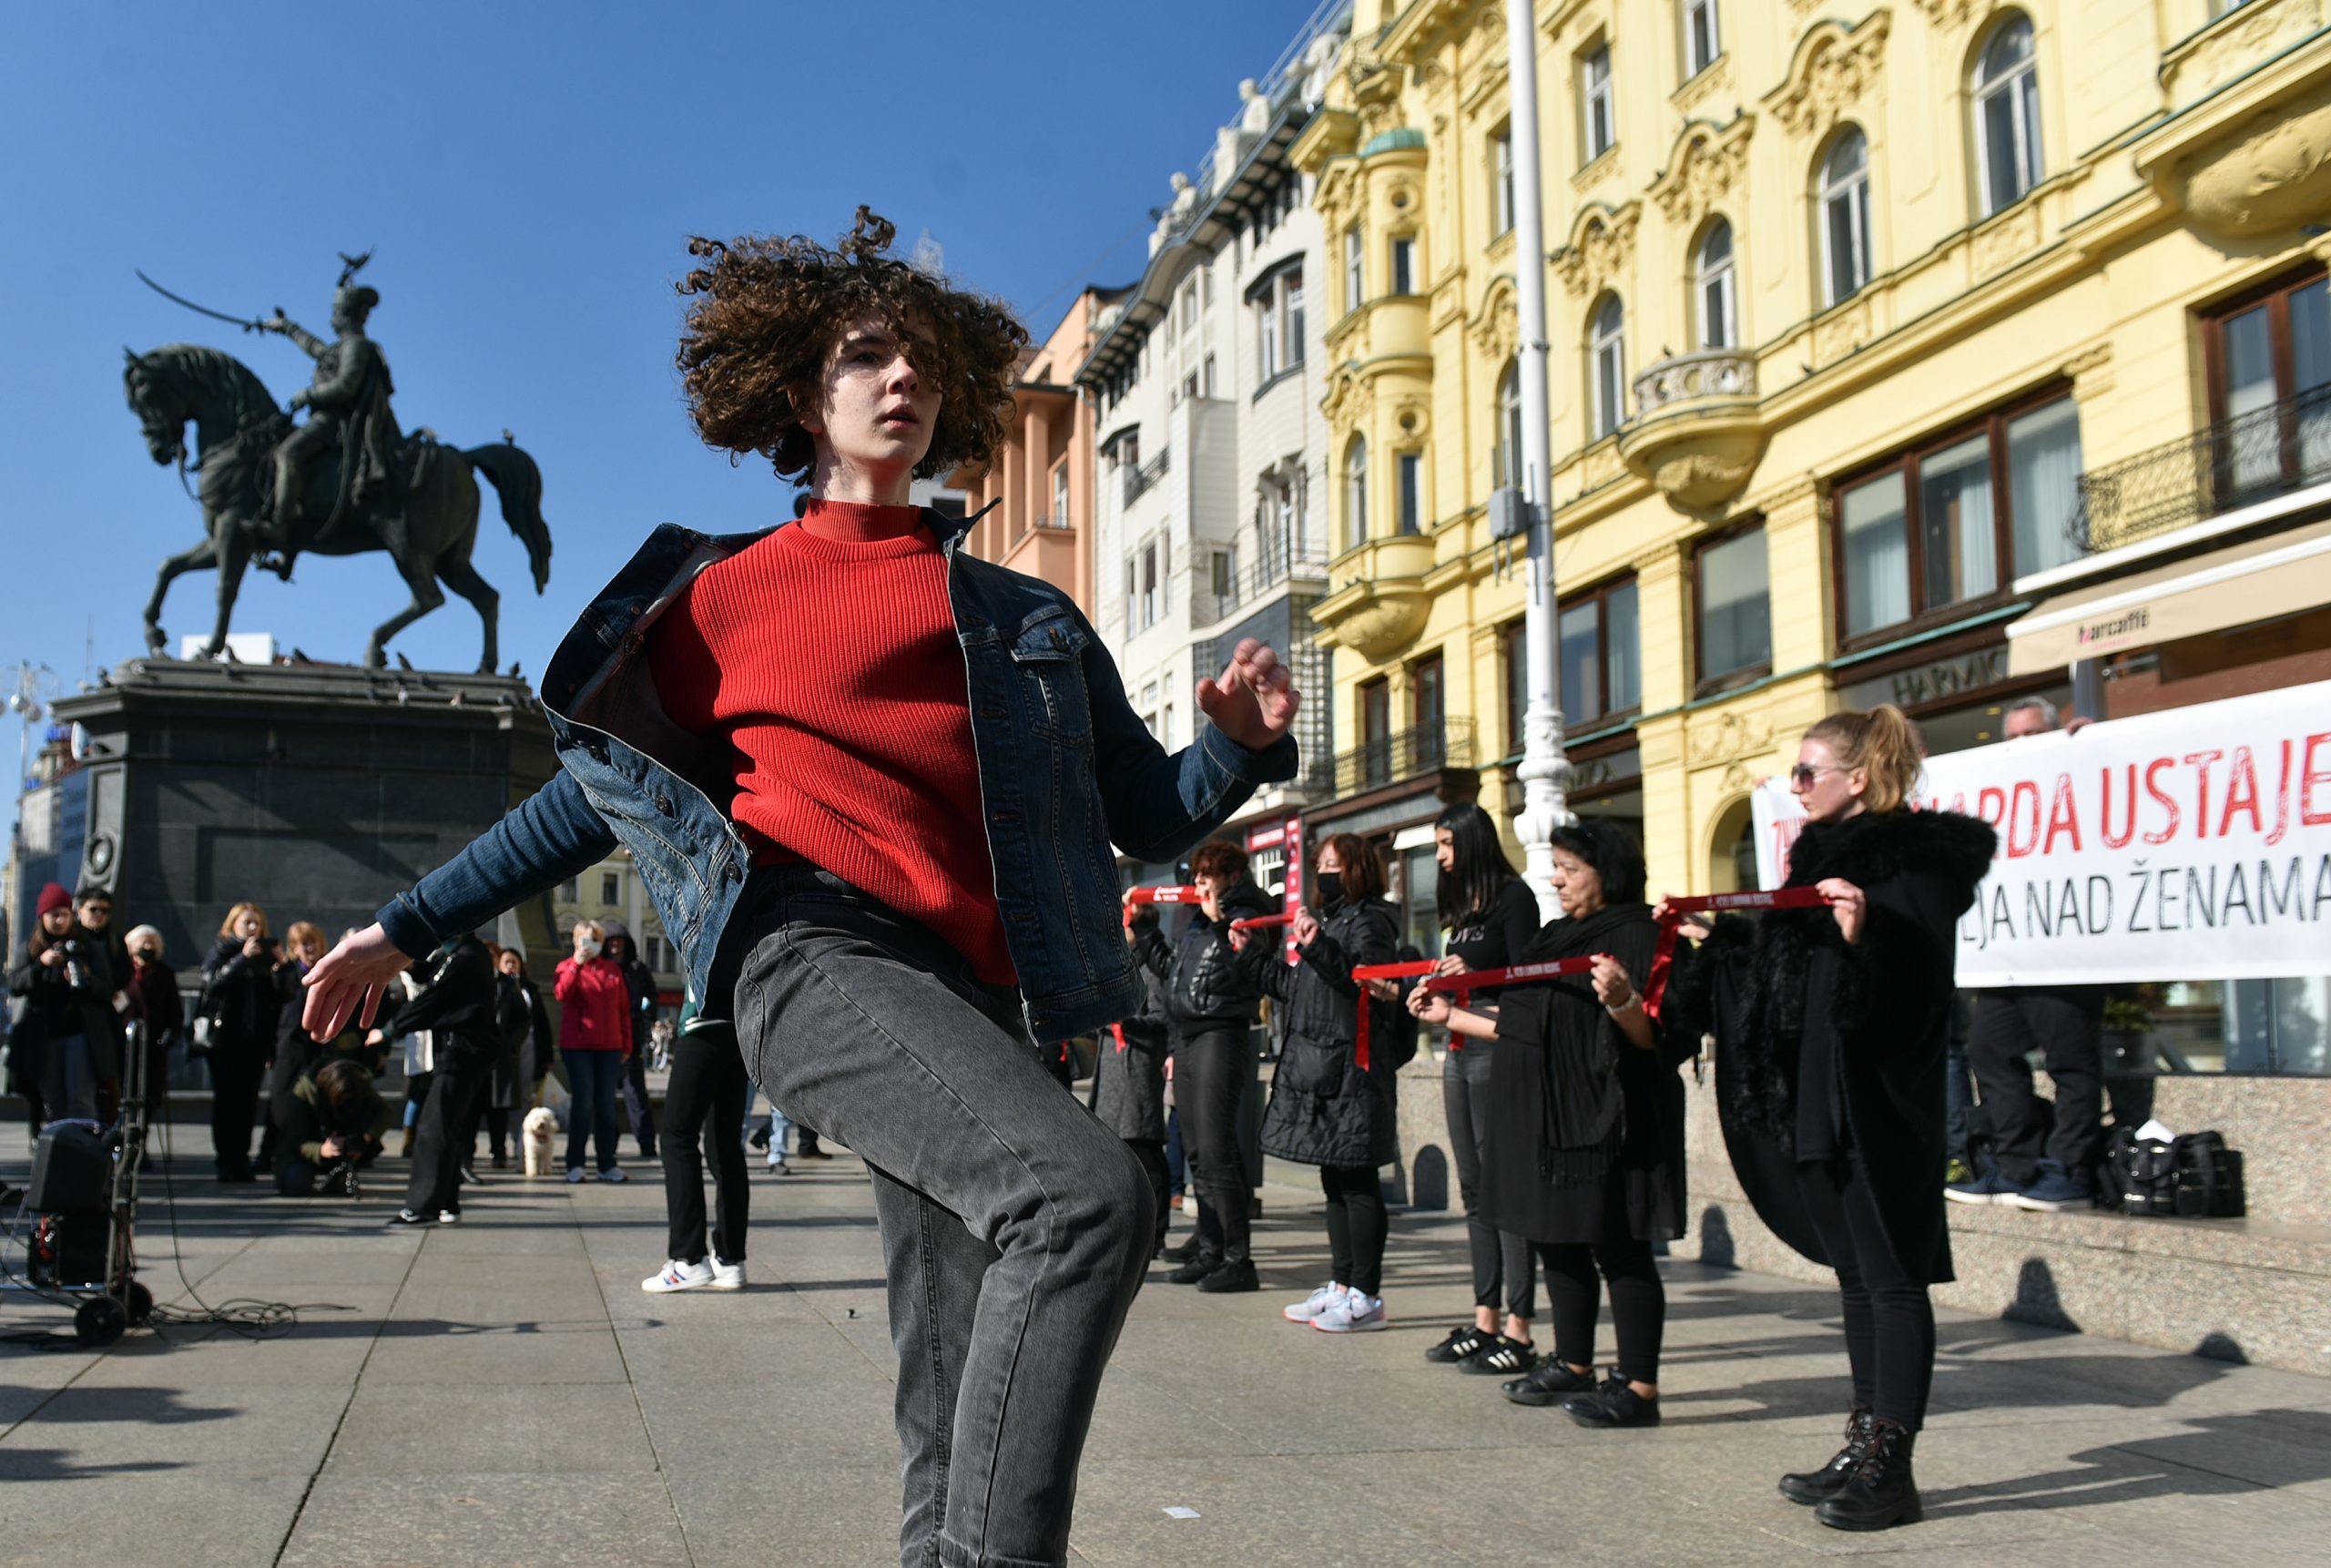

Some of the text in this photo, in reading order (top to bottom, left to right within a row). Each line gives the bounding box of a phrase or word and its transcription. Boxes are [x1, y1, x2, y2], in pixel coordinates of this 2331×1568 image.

[2101, 731, 2331, 849] USTAJE
[2026, 875, 2113, 938] NAD
[2128, 852, 2331, 932] ŽENAMA
